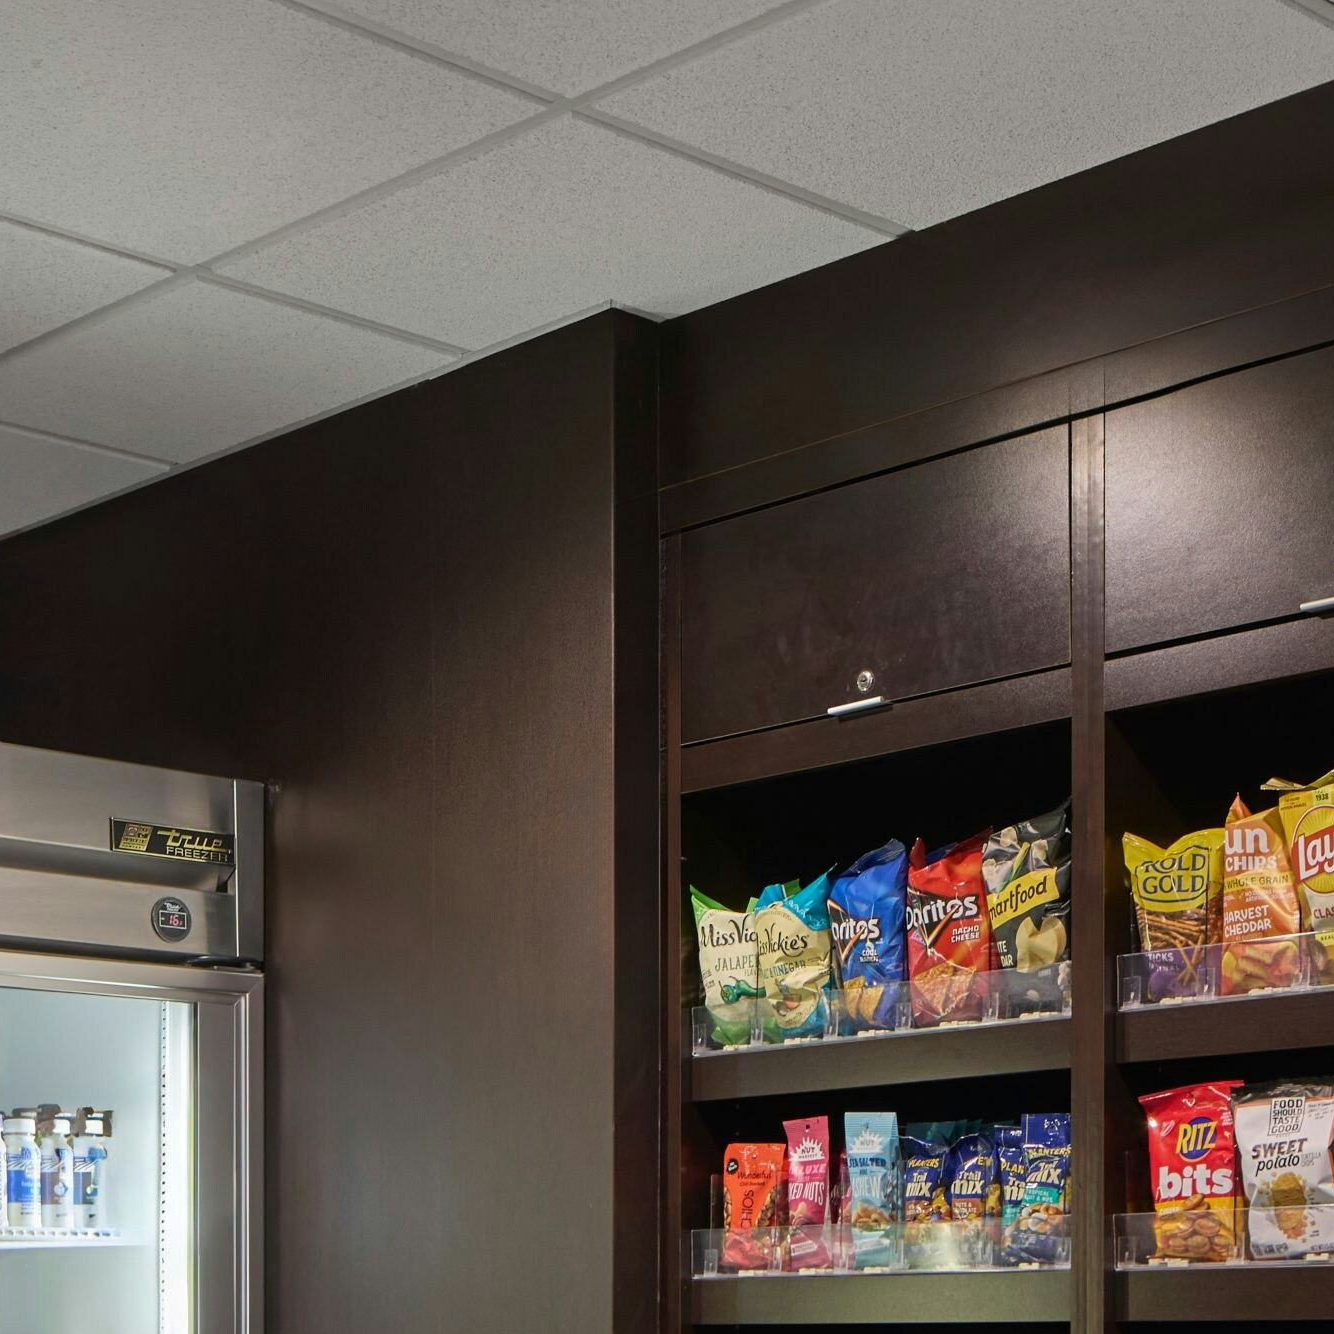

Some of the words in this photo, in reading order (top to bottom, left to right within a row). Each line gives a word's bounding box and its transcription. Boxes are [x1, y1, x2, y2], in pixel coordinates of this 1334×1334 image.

[1225, 827, 1270, 854] un
[166, 846, 228, 862] FREEZER
[1225, 855, 1277, 872] CHIPS
[1142, 874, 1207, 896] GOLD
[1227, 875, 1255, 890] WHOLE
[1258, 874, 1289, 888] GRAIN
[989, 875, 1048, 921] martfood
[906, 895, 978, 931] Doritos
[1225, 905, 1270, 923] HARVEST
[701, 923, 735, 949] Miss
[830, 917, 880, 942] oritos
[950, 932, 980, 944] CHEESE
[951, 924, 980, 936] NACHO
[1224, 918, 1273, 938] CHEDDAR
[764, 922, 809, 958] Vickie's
[1272, 1107, 1303, 1118] SHOULD
[1273, 1098, 1303, 1109] FOOD
[1271, 1123, 1300, 1134] GOOD
[1272, 1115, 1301, 1126] TASTE
[1175, 1121, 1219, 1155] RITZ
[1251, 1138, 1308, 1161] SWEET
[1255, 1154, 1301, 1177] potato
[1158, 1163, 1234, 1200] bits
[804, 1182, 825, 1206] NUTS
